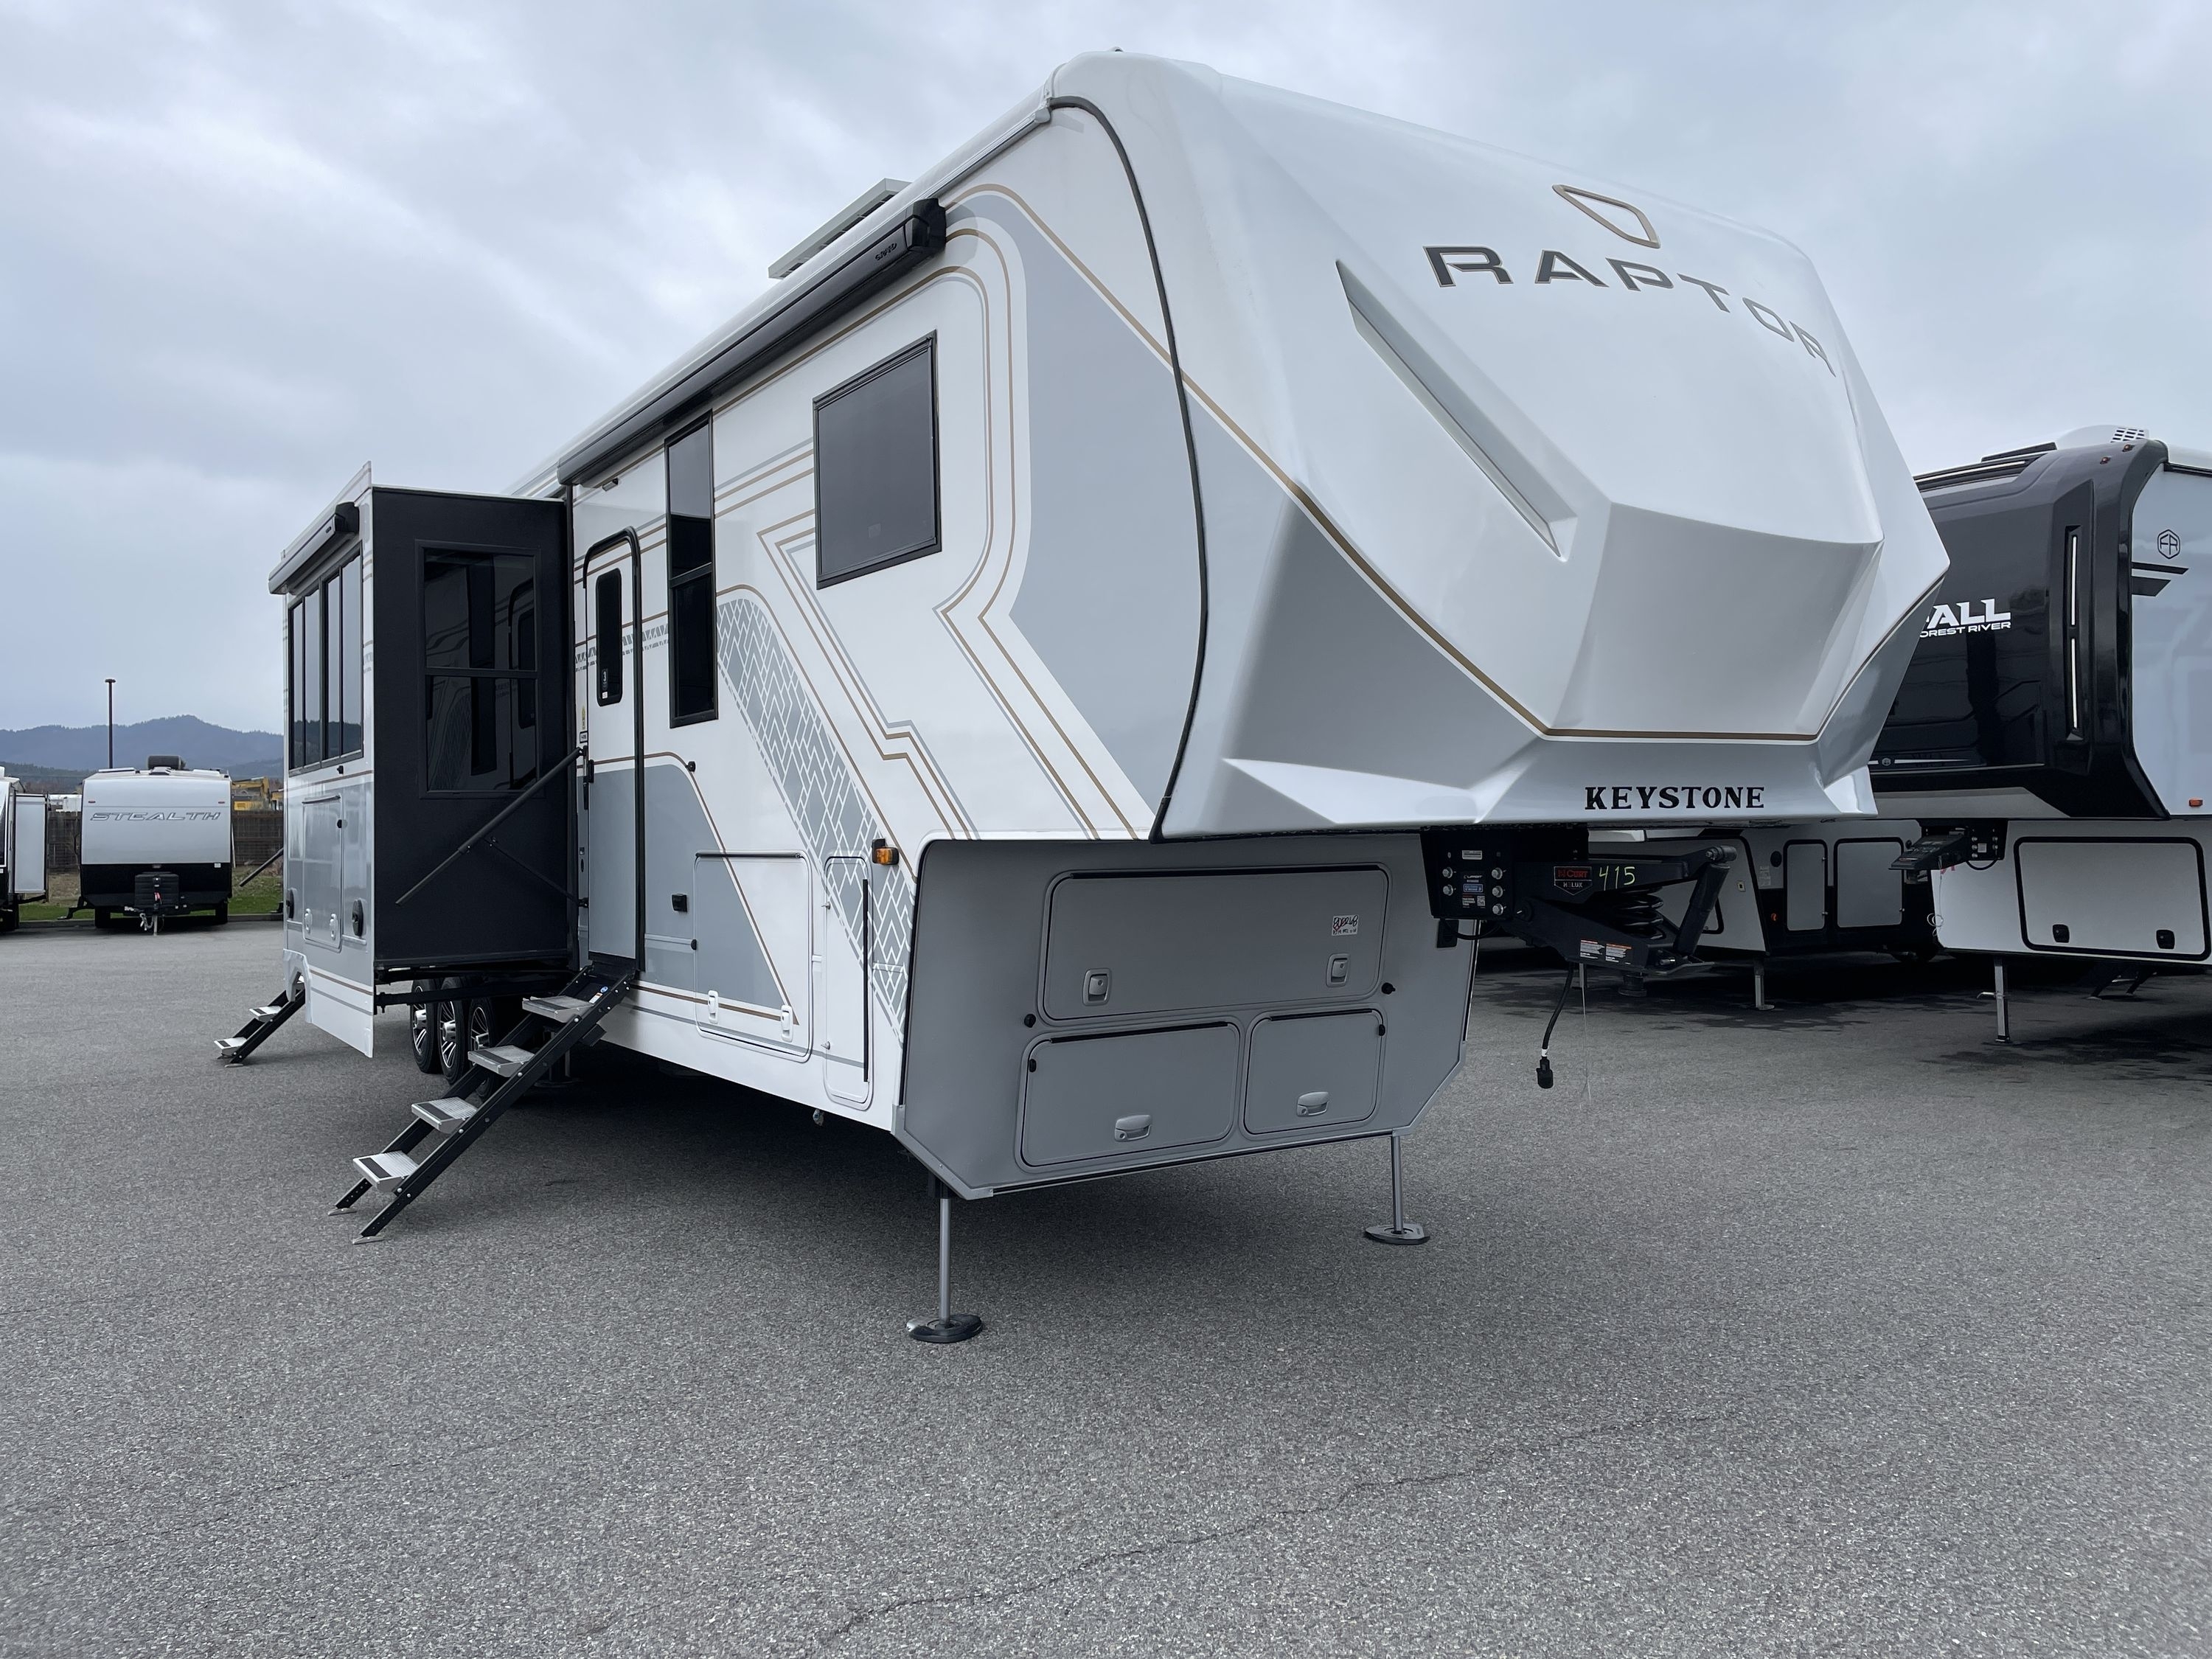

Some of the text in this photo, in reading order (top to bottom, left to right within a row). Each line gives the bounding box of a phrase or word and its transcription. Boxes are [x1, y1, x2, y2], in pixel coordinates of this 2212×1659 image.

[1422, 245, 1836, 378] RAPTOR
[1925, 598, 2011, 629] ALL
[1919, 622, 2011, 638] OREST RIVER
[1585, 786, 1765, 810] KEYSTONE
[89, 812, 221, 821] STEALTH
[1599, 865, 1635, 891] 415
